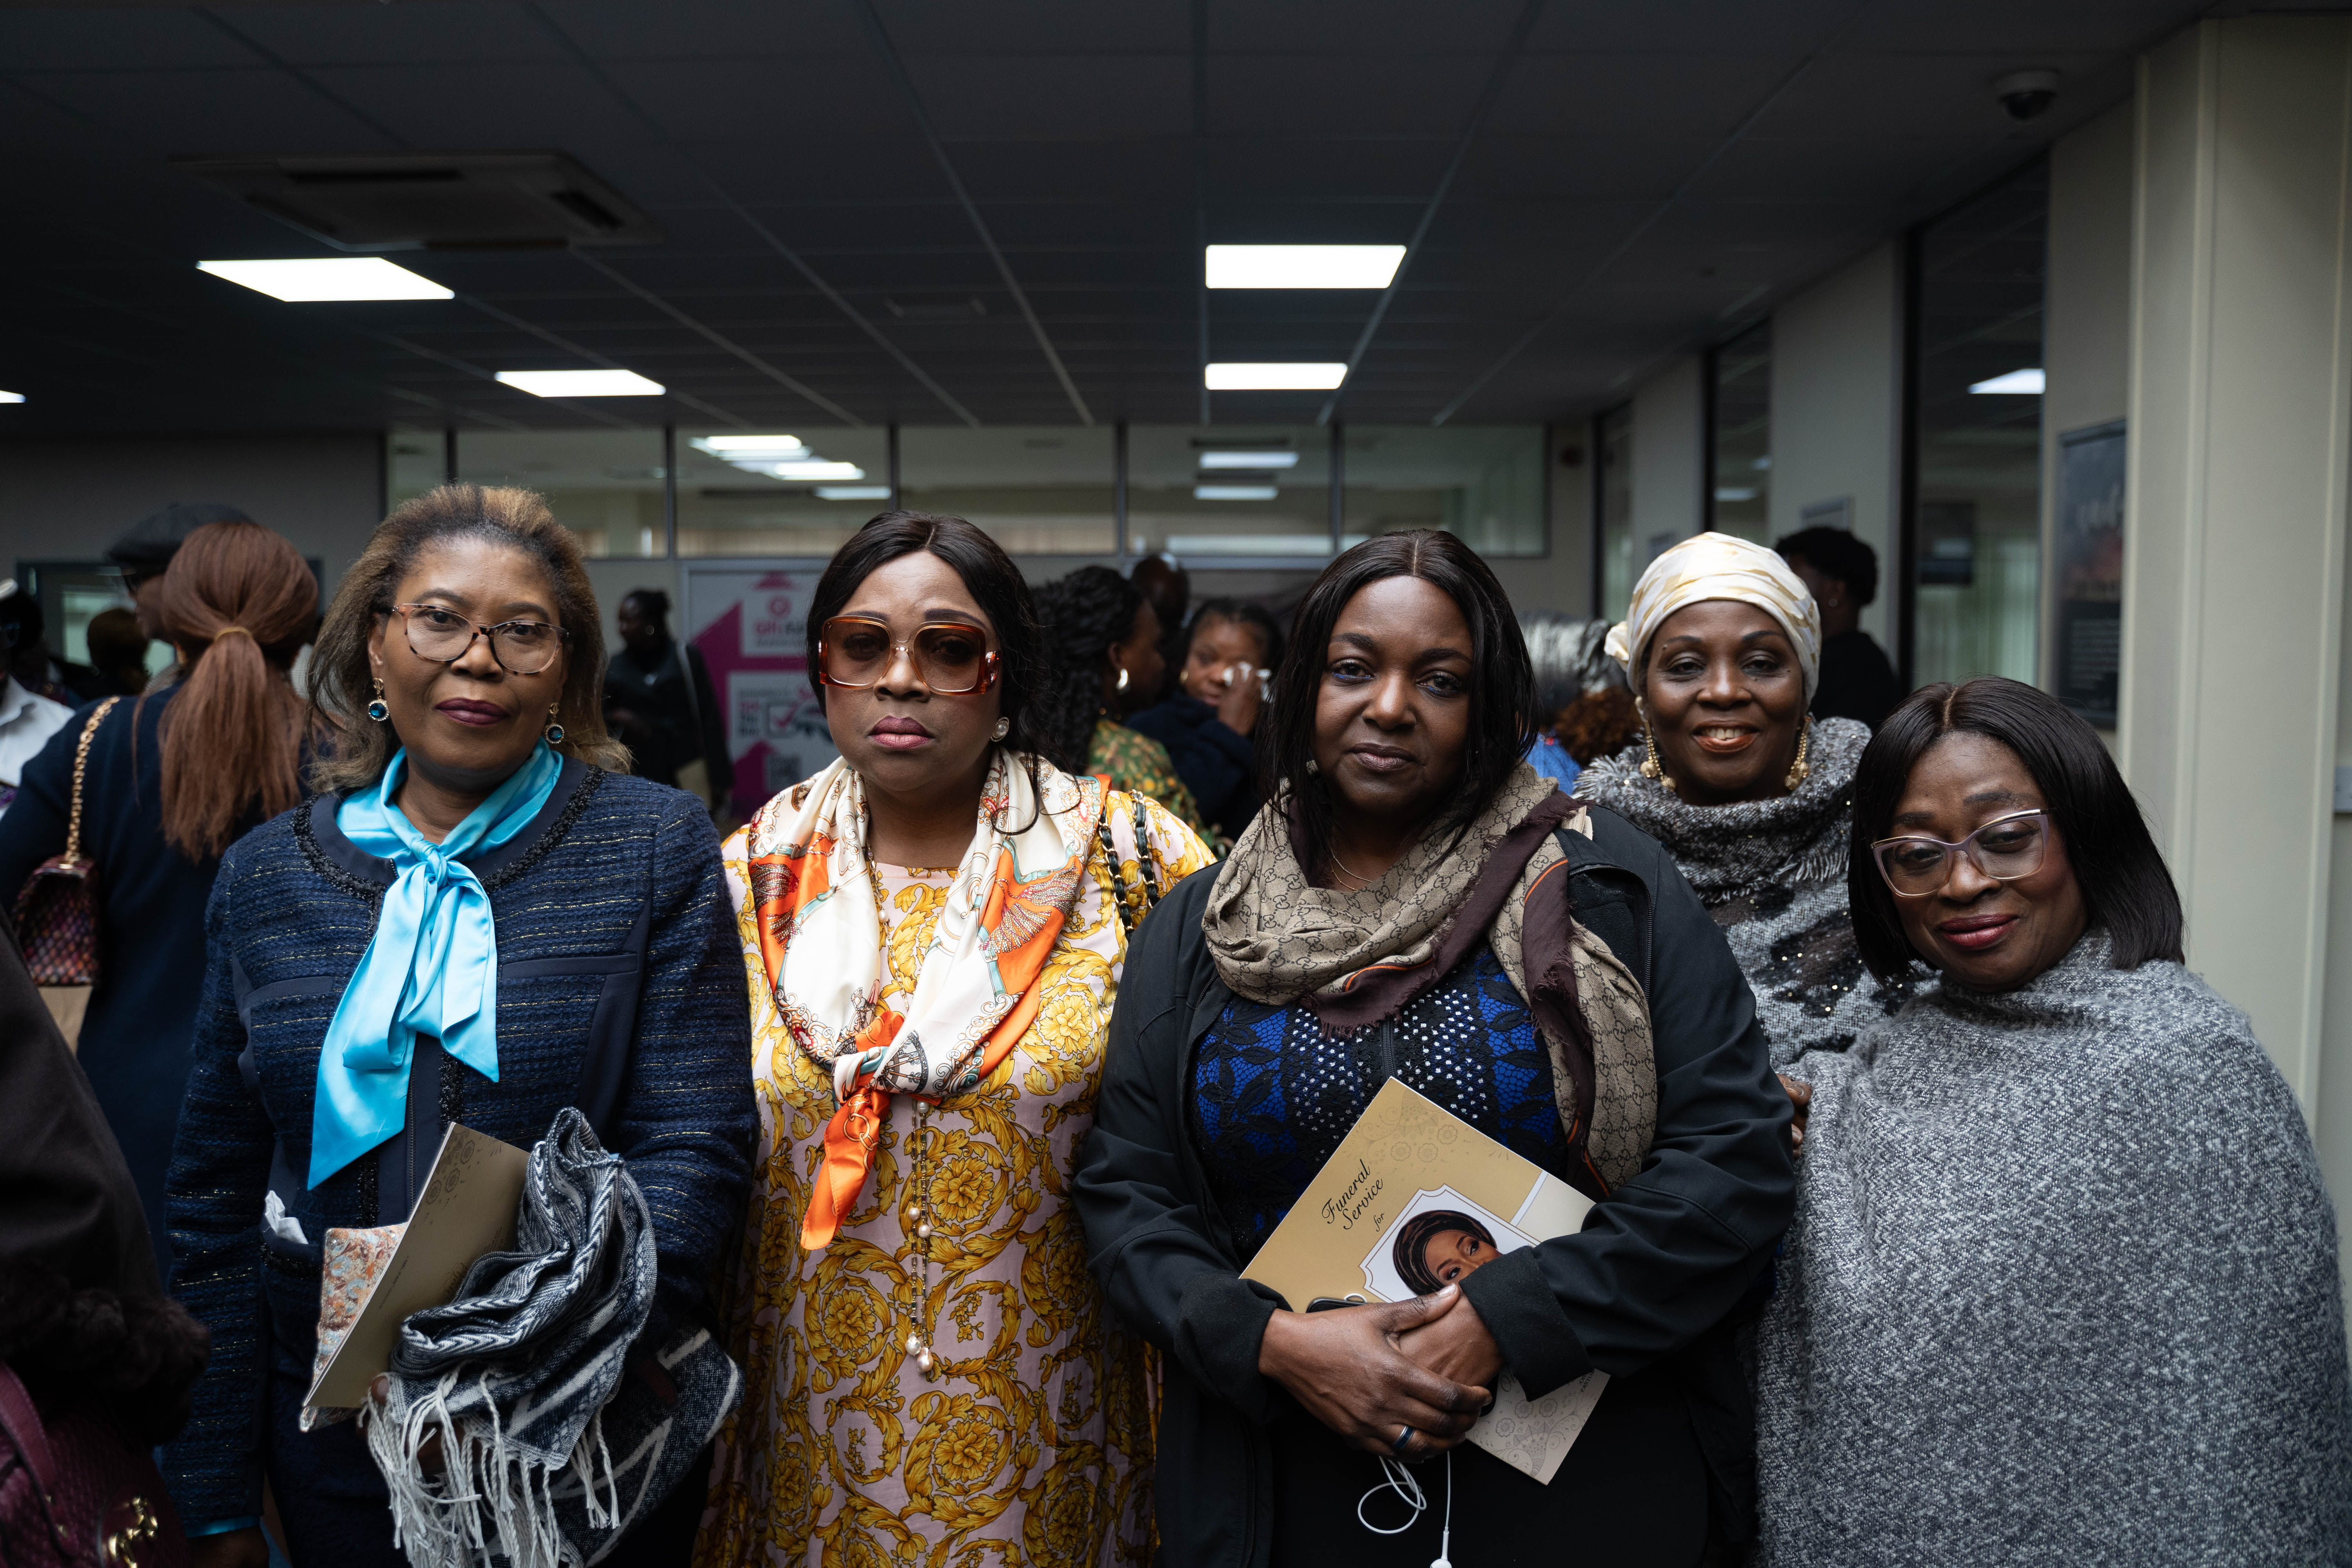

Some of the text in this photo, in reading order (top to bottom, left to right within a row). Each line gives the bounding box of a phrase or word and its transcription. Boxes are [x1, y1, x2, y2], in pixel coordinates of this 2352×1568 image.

[1321, 1158, 1370, 1224] Funeral
[1342, 1178, 1383, 1230] Service
[1374, 1212, 1385, 1232] for
